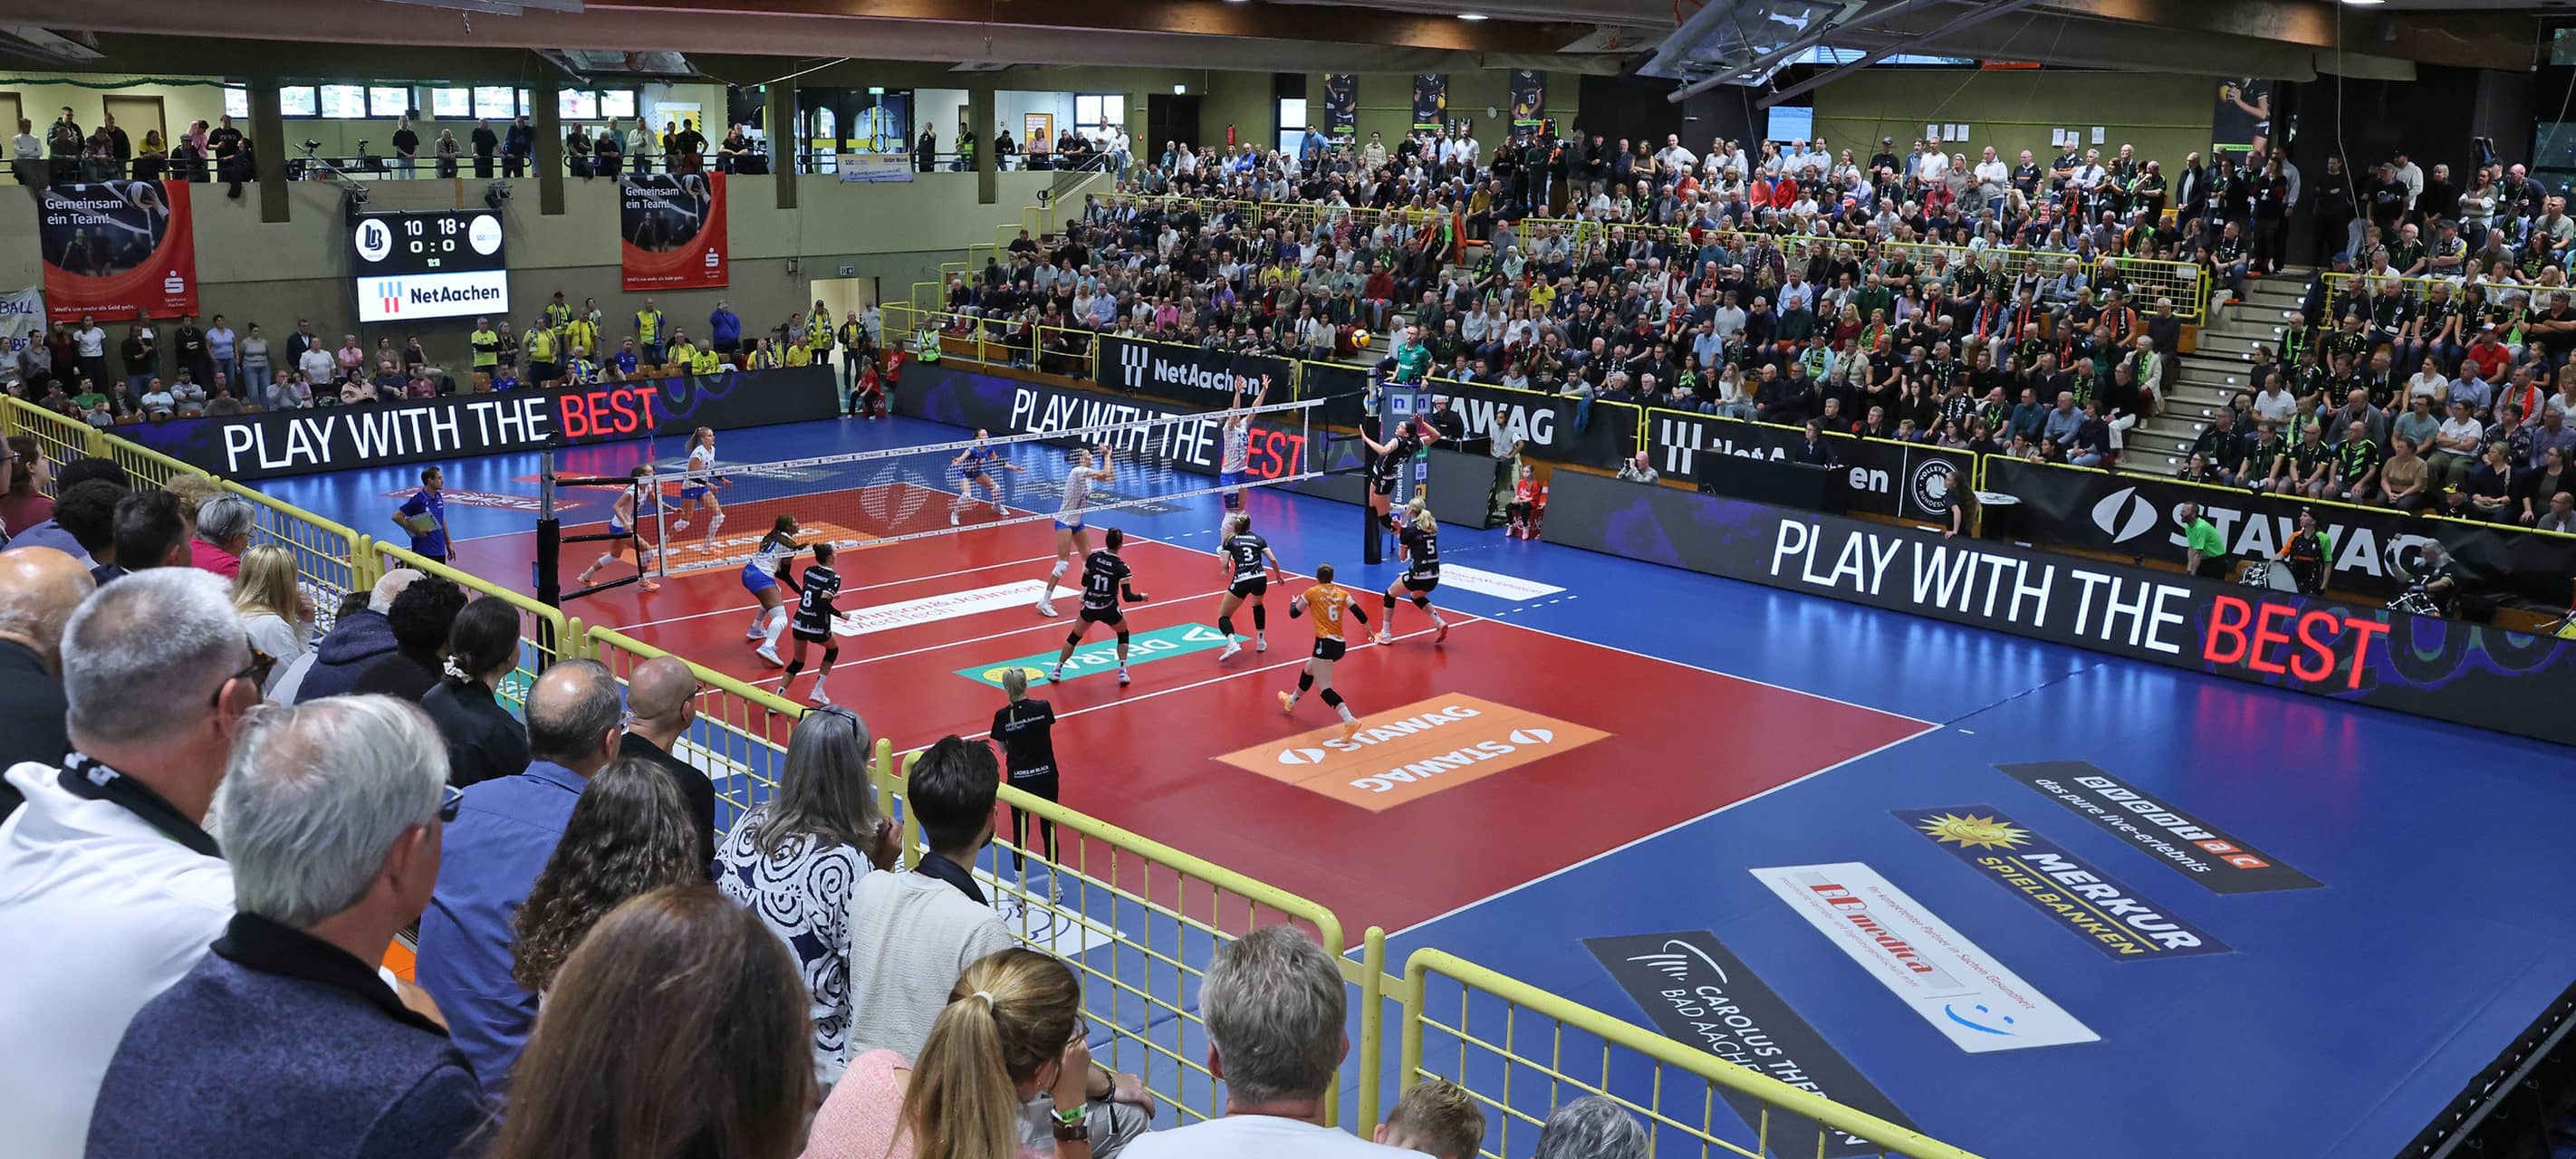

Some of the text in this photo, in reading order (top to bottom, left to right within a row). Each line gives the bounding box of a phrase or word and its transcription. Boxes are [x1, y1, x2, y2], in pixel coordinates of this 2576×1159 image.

[45, 197, 123, 209] Gemeinsam
[626, 187, 679, 196] Gemeinsam
[626, 199, 671, 208] ein Team!
[47, 213, 110, 225] ein Team!
[404, 218, 457, 235] 10 18
[410, 284, 500, 304] NetAachen
[1154, 358, 1260, 396] NetAachen
[223, 387, 658, 473] PLAY WITH THE BEST
[1010, 388, 1308, 482] PLAY WITH THE EST
[1395, 478, 1403, 503] Bauen
[1242, 547, 1254, 561] 3
[1427, 539, 1436, 554] 5
[1092, 574, 1110, 591] 11
[2420, 574, 2430, 585] 7
[803, 589, 812, 608] 8
[1770, 518, 2391, 690] PLAY WITH THE BEST
[1328, 604, 1340, 622] 6
[1042, 637, 1180, 670] DEKRA
[1322, 705, 1481, 752] STAWAG
[1349, 740, 1515, 793] STAWAG
[2035, 779, 2212, 874] das pure live-erlebnis
[1977, 857, 2145, 954] SPIELBANKEN
[2021, 853, 2202, 950] MERKUR
[1809, 883, 1868, 912] BB
[1846, 914, 1934, 973] medica
[1660, 989, 1705, 1018] BAD
[1695, 985, 1783, 1057] CAROLUS
